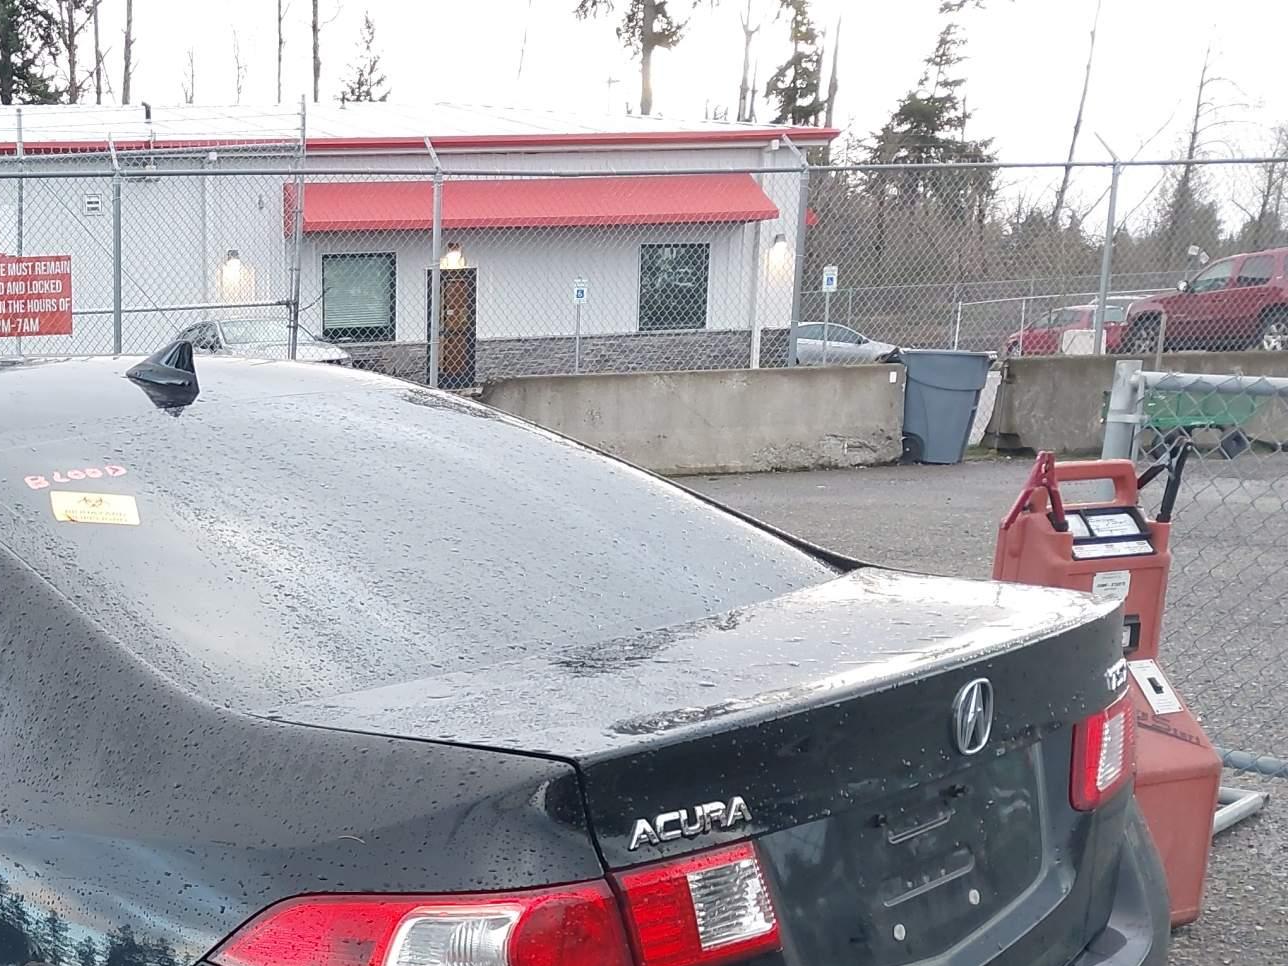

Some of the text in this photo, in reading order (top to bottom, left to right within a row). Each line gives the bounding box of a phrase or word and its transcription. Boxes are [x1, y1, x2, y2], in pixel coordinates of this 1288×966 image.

[8, 262, 33, 276] MUST
[34, 260, 70, 275] REMAIN
[6, 281, 25, 295] AND
[27, 280, 62, 293] LOCKED
[8, 300, 25, 313] THE
[27, 299, 57, 312] HOURS
[59, 298, 71, 312] OF
[629, 796, 753, 850] ACURA
